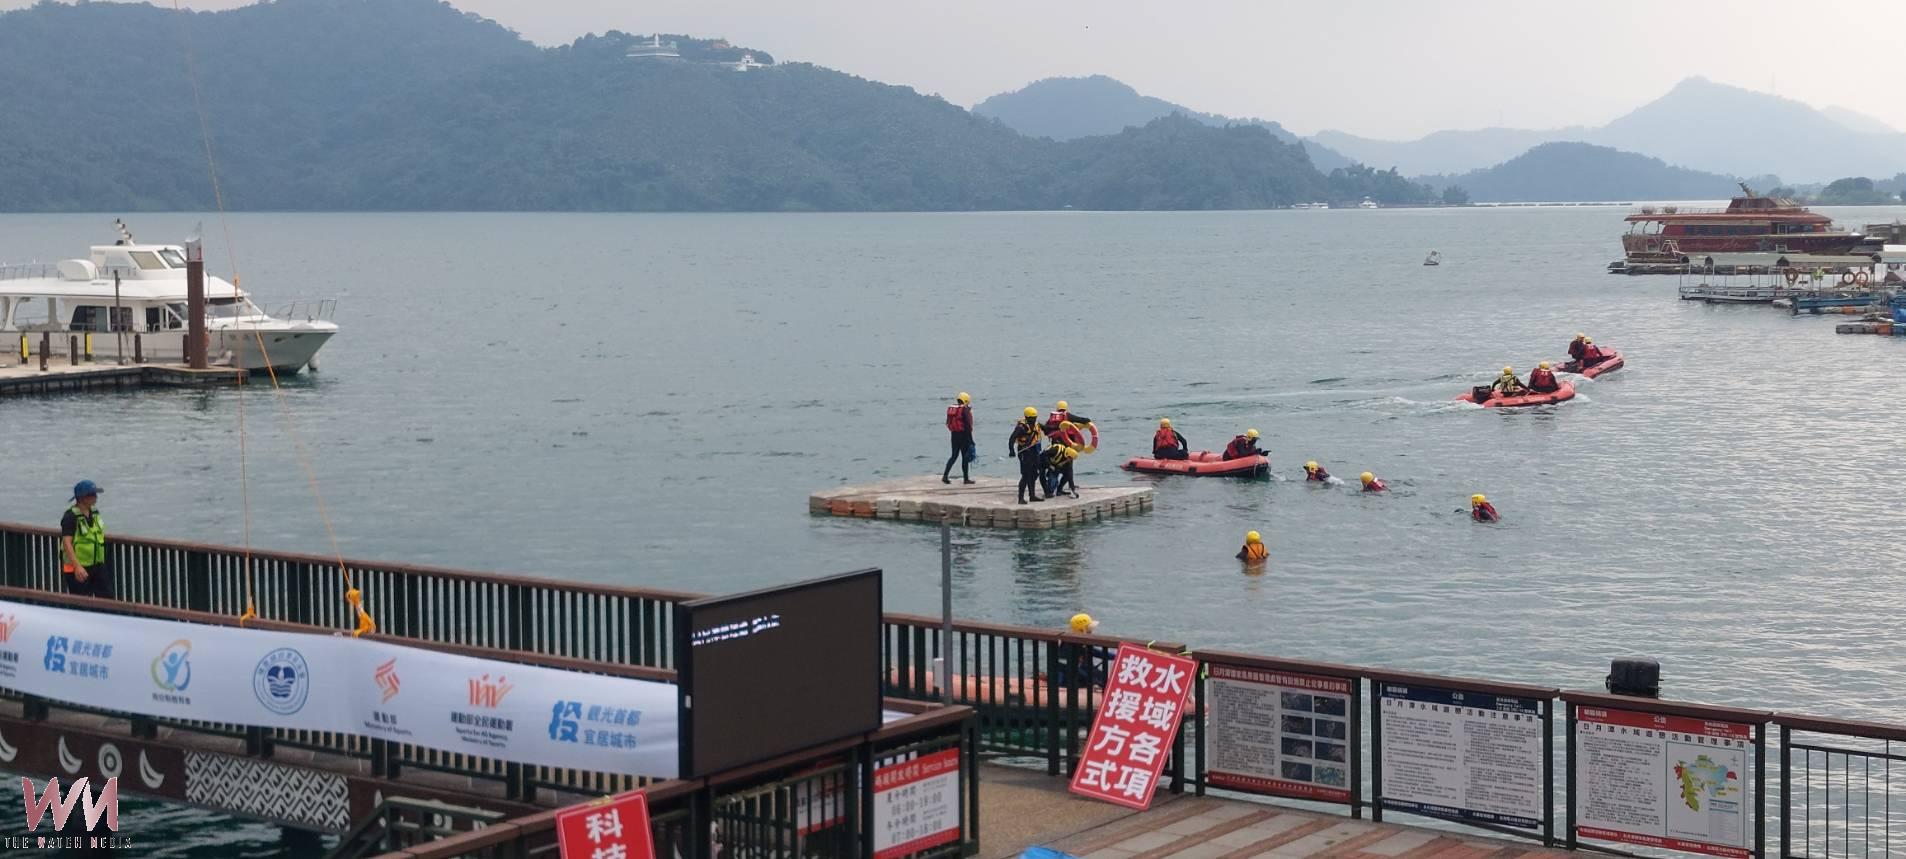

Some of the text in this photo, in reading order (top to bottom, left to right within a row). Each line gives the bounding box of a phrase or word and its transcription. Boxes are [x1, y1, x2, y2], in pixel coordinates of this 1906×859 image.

[584, 729, 637, 749] 宜居城市
[588, 705, 642, 726] 觀光首都
[1080, 654, 1153, 792] 救援方式
[1113, 663, 1185, 800] 水域各項
